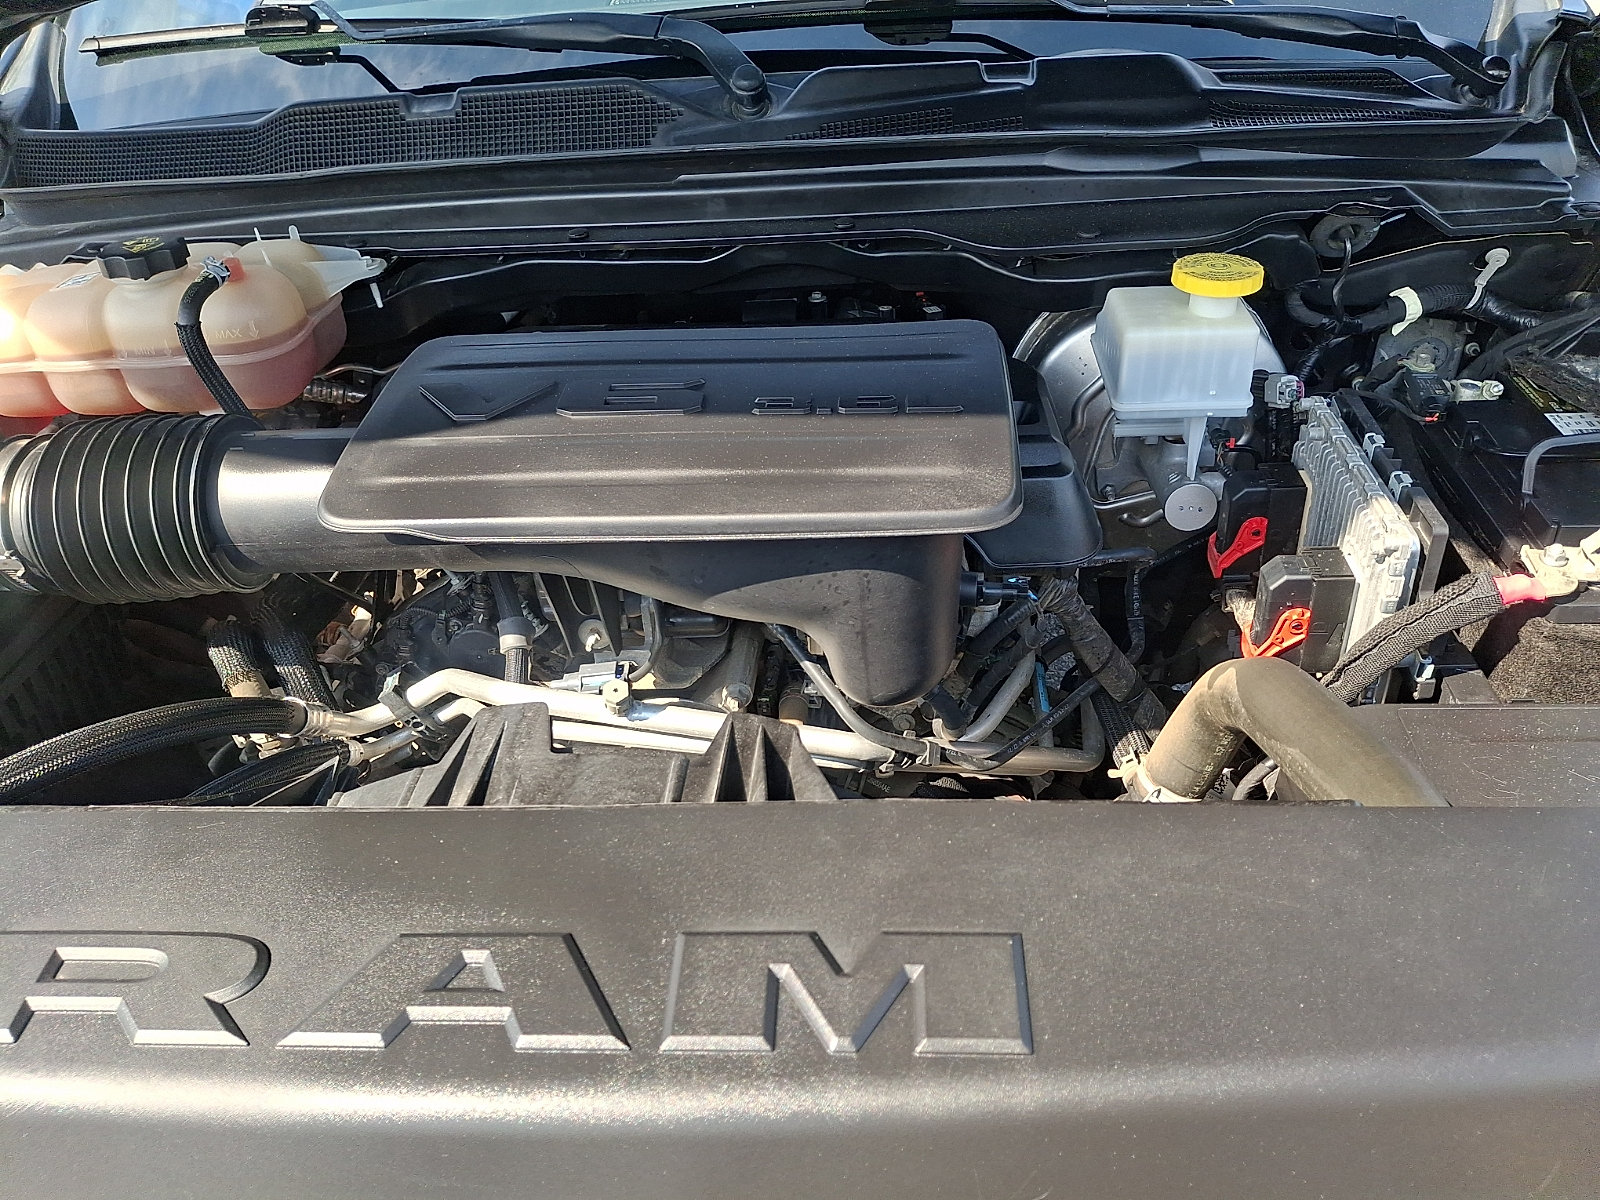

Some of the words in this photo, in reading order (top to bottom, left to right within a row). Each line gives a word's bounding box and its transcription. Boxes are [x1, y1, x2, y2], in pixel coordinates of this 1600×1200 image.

[215, 328, 242, 339] MAX
[135, 344, 156, 356] MIN
[418, 376, 706, 421] V6
[0, 930, 1035, 1056] RAM
